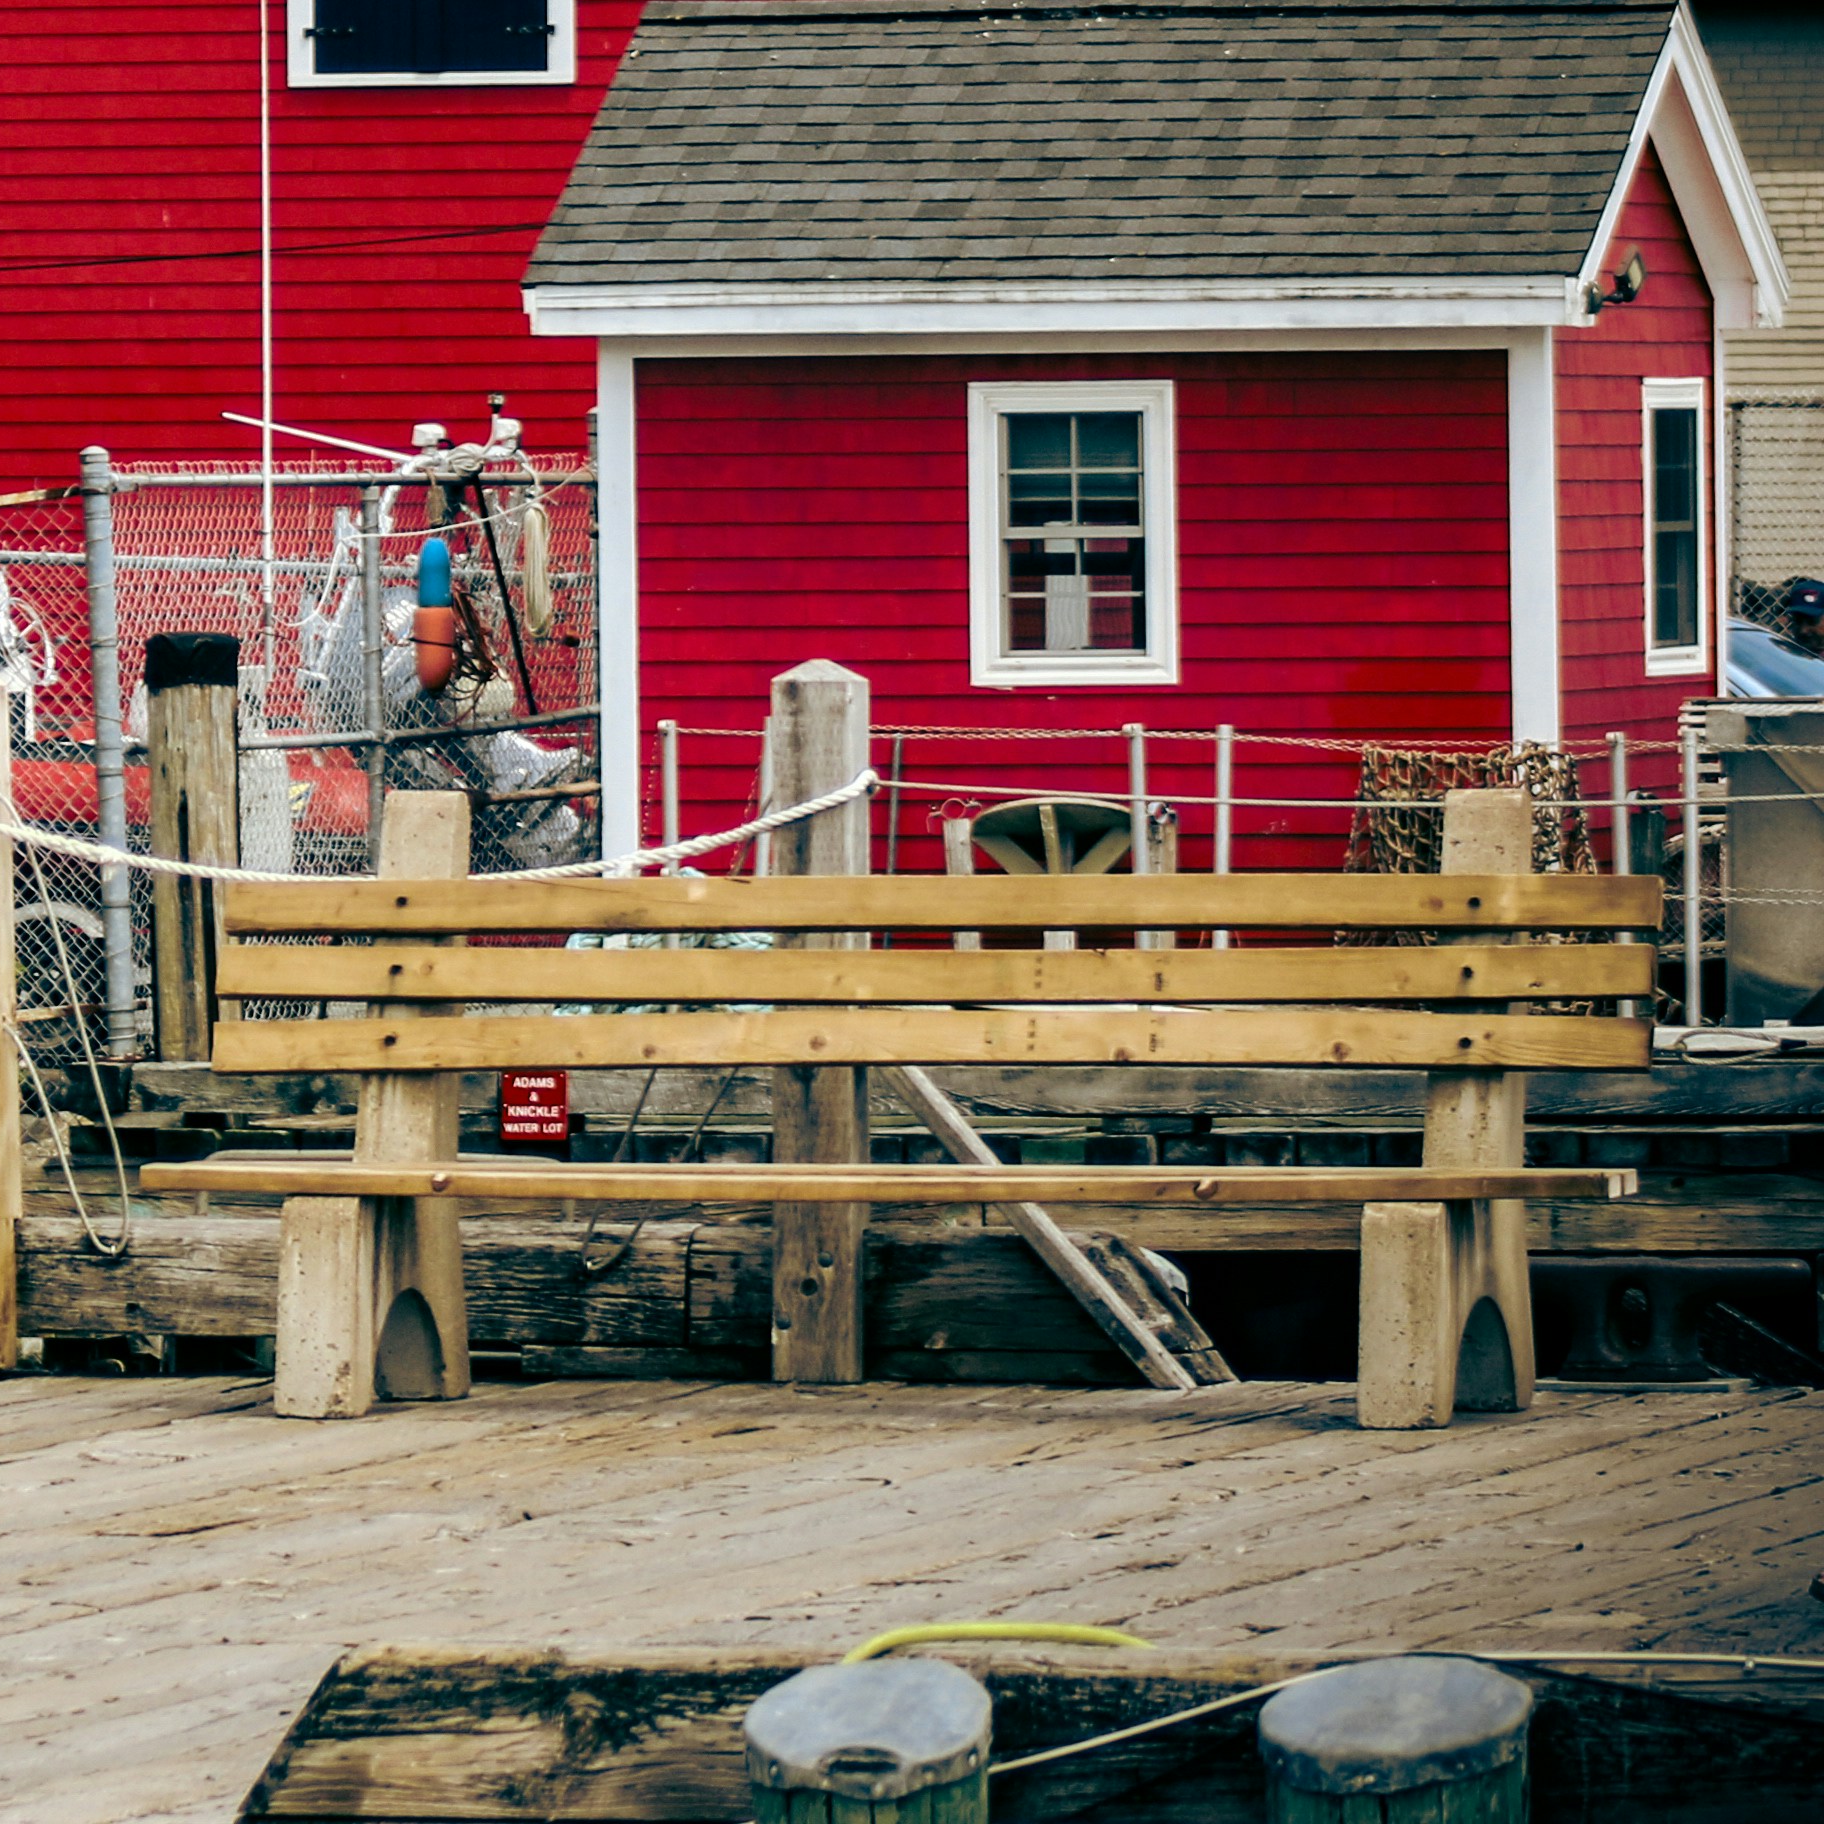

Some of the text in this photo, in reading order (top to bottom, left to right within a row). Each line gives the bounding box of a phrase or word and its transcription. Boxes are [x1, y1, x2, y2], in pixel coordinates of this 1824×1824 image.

[513, 1077, 556, 1088] ADAMS
[529, 1091, 539, 1102] &
[507, 1105, 560, 1117] KNICKLE
[503, 1122, 564, 1133] WATER LOT
